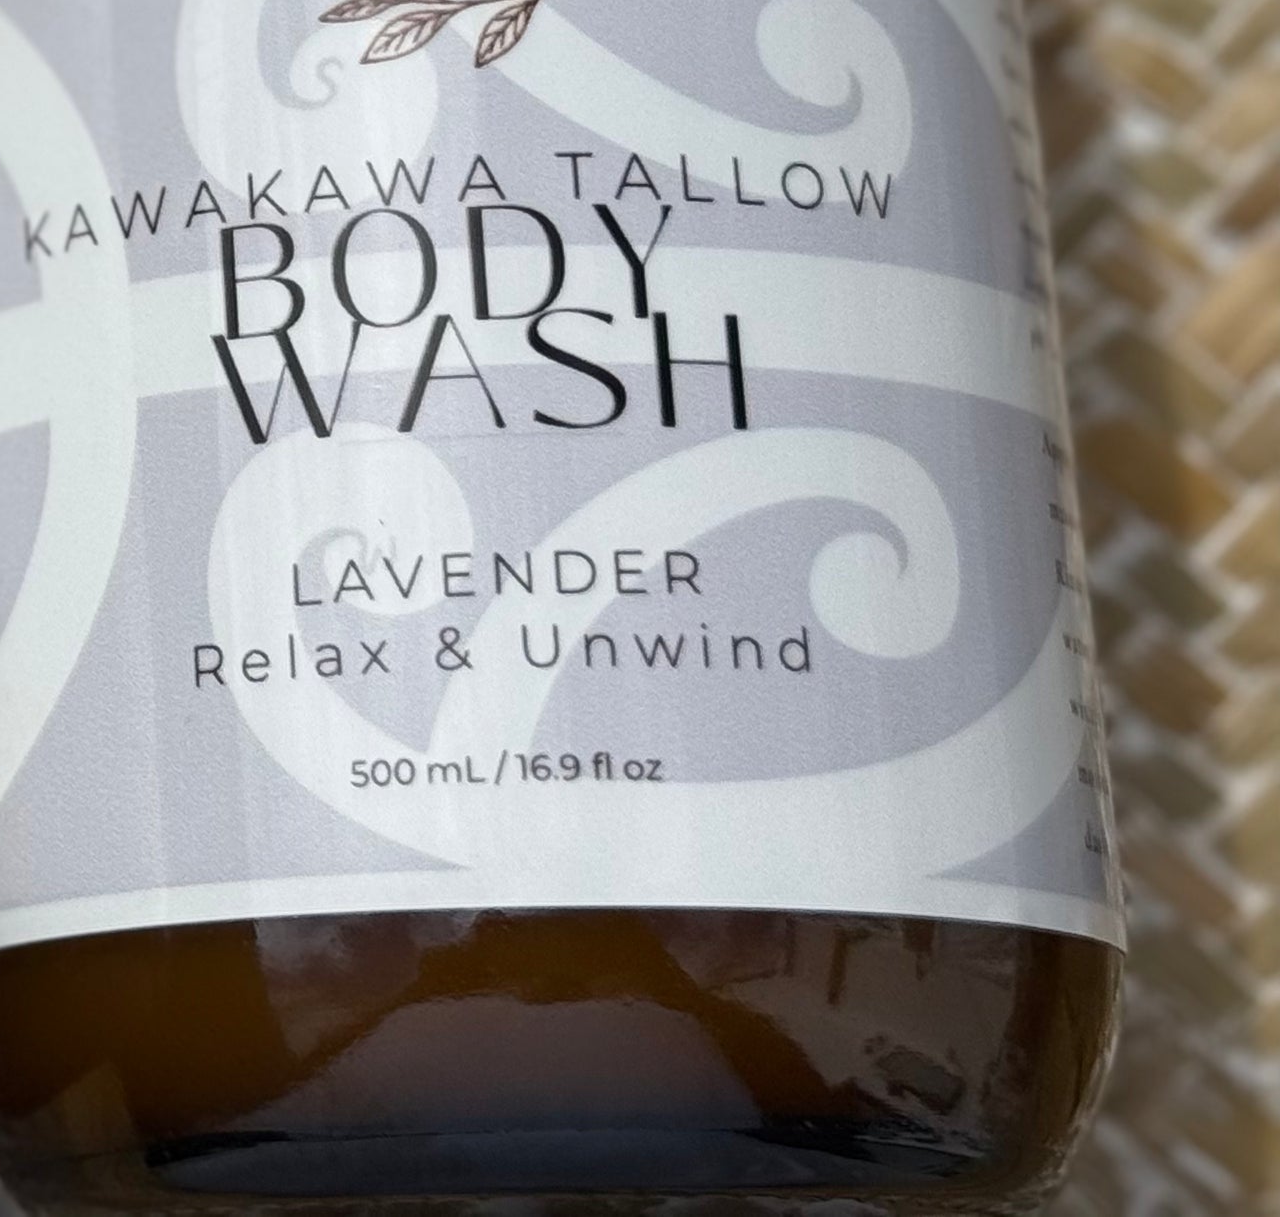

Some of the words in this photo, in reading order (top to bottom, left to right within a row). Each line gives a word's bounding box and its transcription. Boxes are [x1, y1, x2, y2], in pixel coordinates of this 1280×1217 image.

[21, 154, 507, 263] KAWAKAWA
[553, 151, 892, 221] TALLOW
[217, 203, 673, 342] BODY
[210, 308, 749, 446] WASH
[292, 549, 702, 608] LAVENDER
[192, 633, 391, 689] Relax
[434, 625, 474, 673] &
[520, 622, 813, 675] Unwind
[350, 757, 417, 789] 500
[426, 755, 487, 785] mL
[493, 748, 510, 787] /
[514, 752, 583, 783] 16.9
[590, 750, 615, 781] fl
[622, 758, 665, 783] oz
